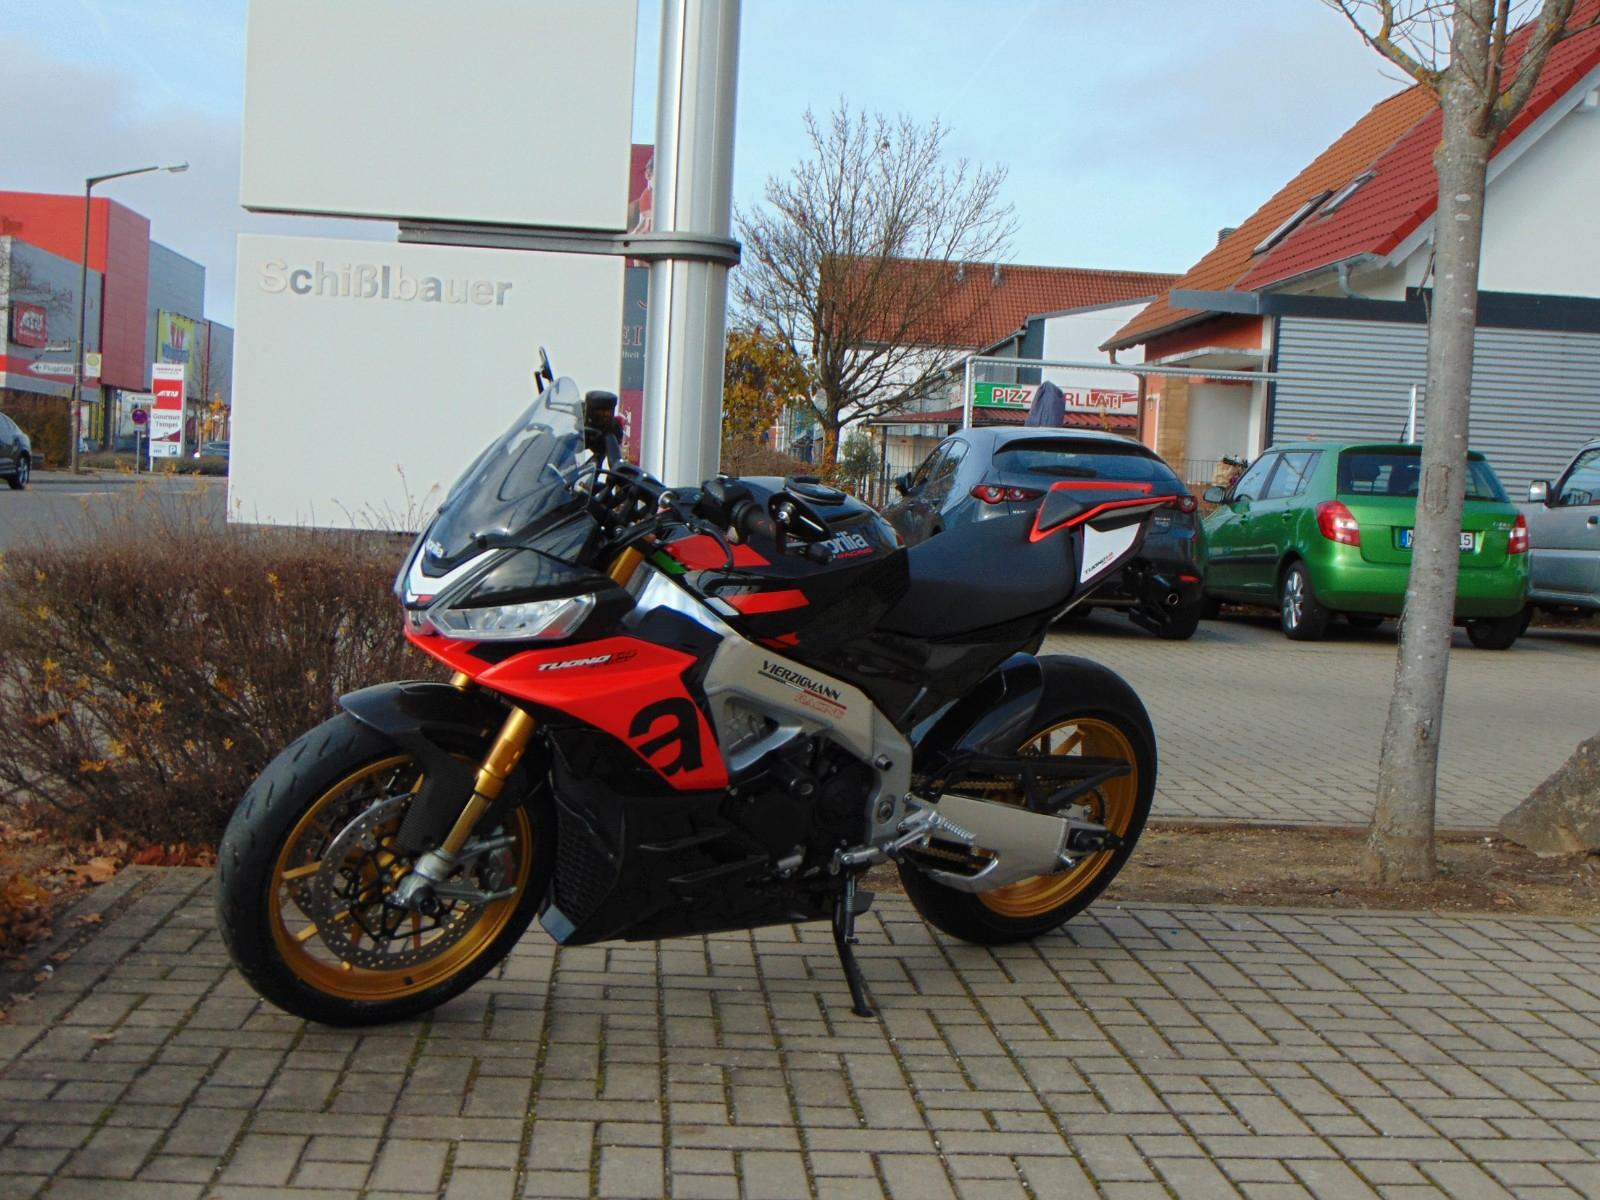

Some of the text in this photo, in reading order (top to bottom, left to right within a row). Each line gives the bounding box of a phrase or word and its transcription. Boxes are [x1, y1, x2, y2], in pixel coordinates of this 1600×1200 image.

[257, 258, 513, 306] Schißlbauer
[992, 387, 1123, 409] PIZZ RLLATI
[152, 413, 180, 421] Gourmet
[155, 421, 179, 430] Tempel
[538, 654, 612, 671] TUONO
[762, 660, 841, 700] VIERZIGMANN
